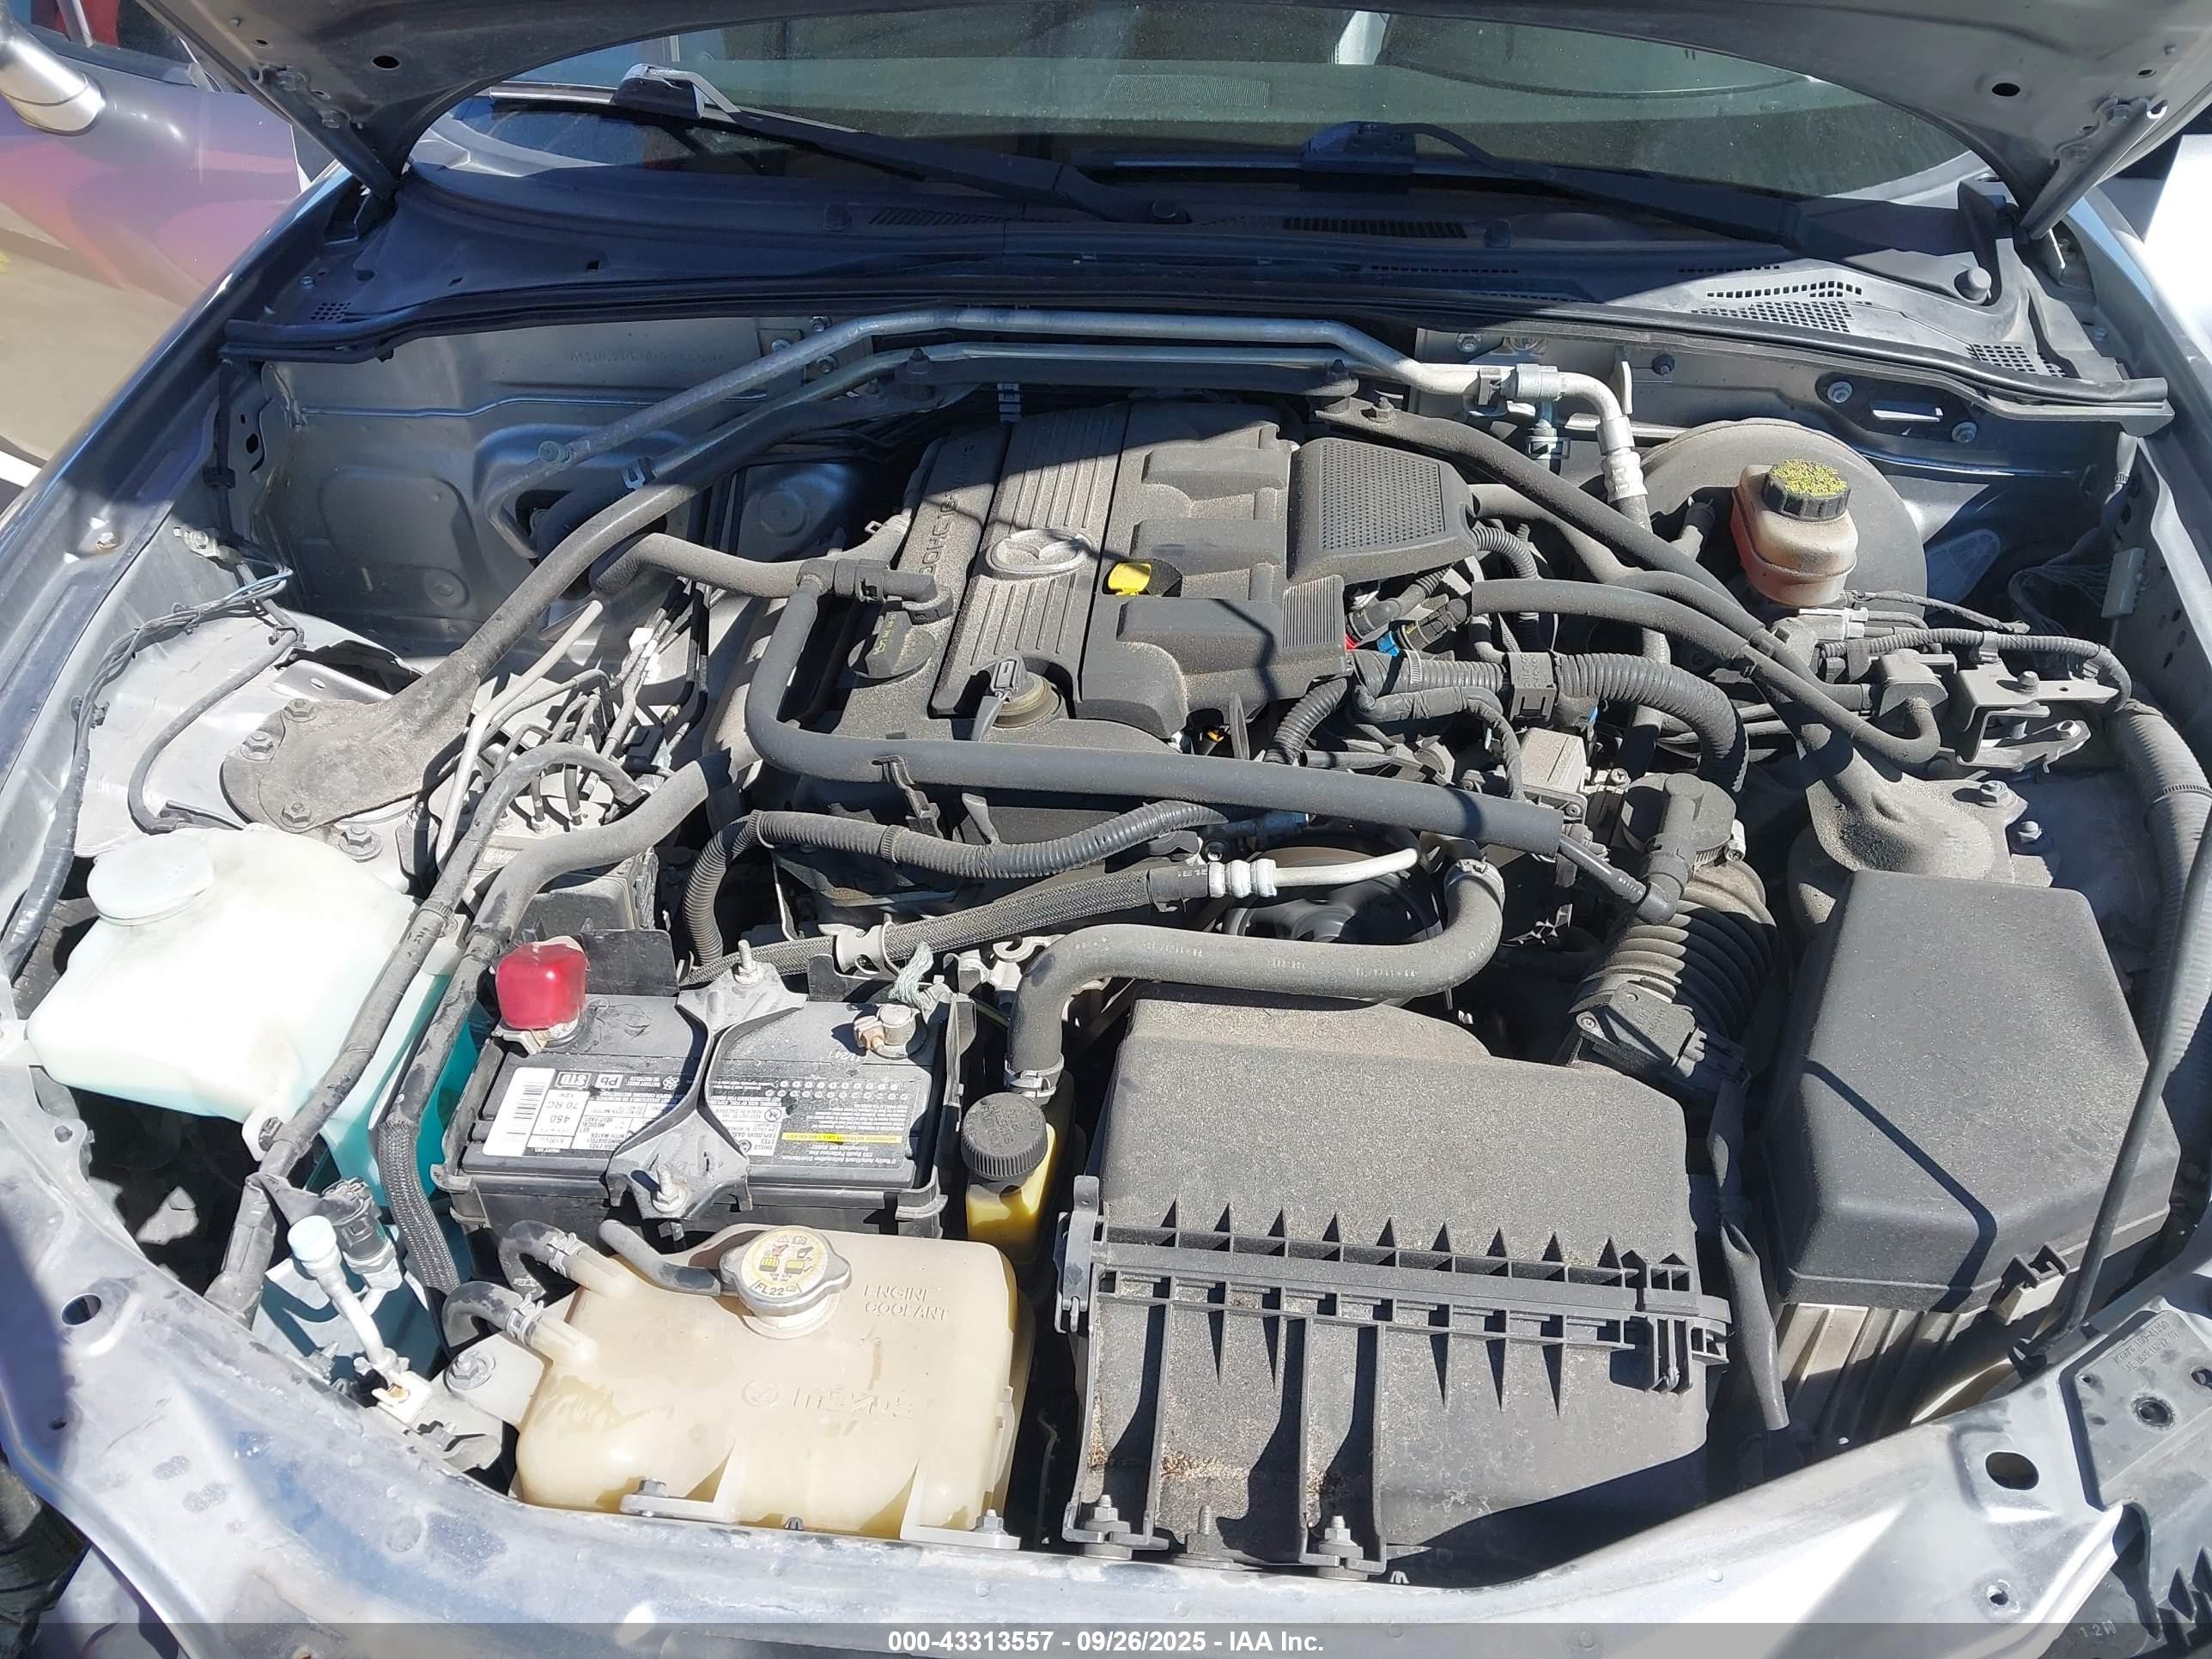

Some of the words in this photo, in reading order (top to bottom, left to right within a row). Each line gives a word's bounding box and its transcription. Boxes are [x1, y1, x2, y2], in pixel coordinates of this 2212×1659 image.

[600, 1077, 619, 1085] Pb
[547, 1101, 562, 1109] RC
[566, 1101, 578, 1109] 70
[550, 1115, 570, 1124] 450
[754, 1282, 785, 1296] FL22
